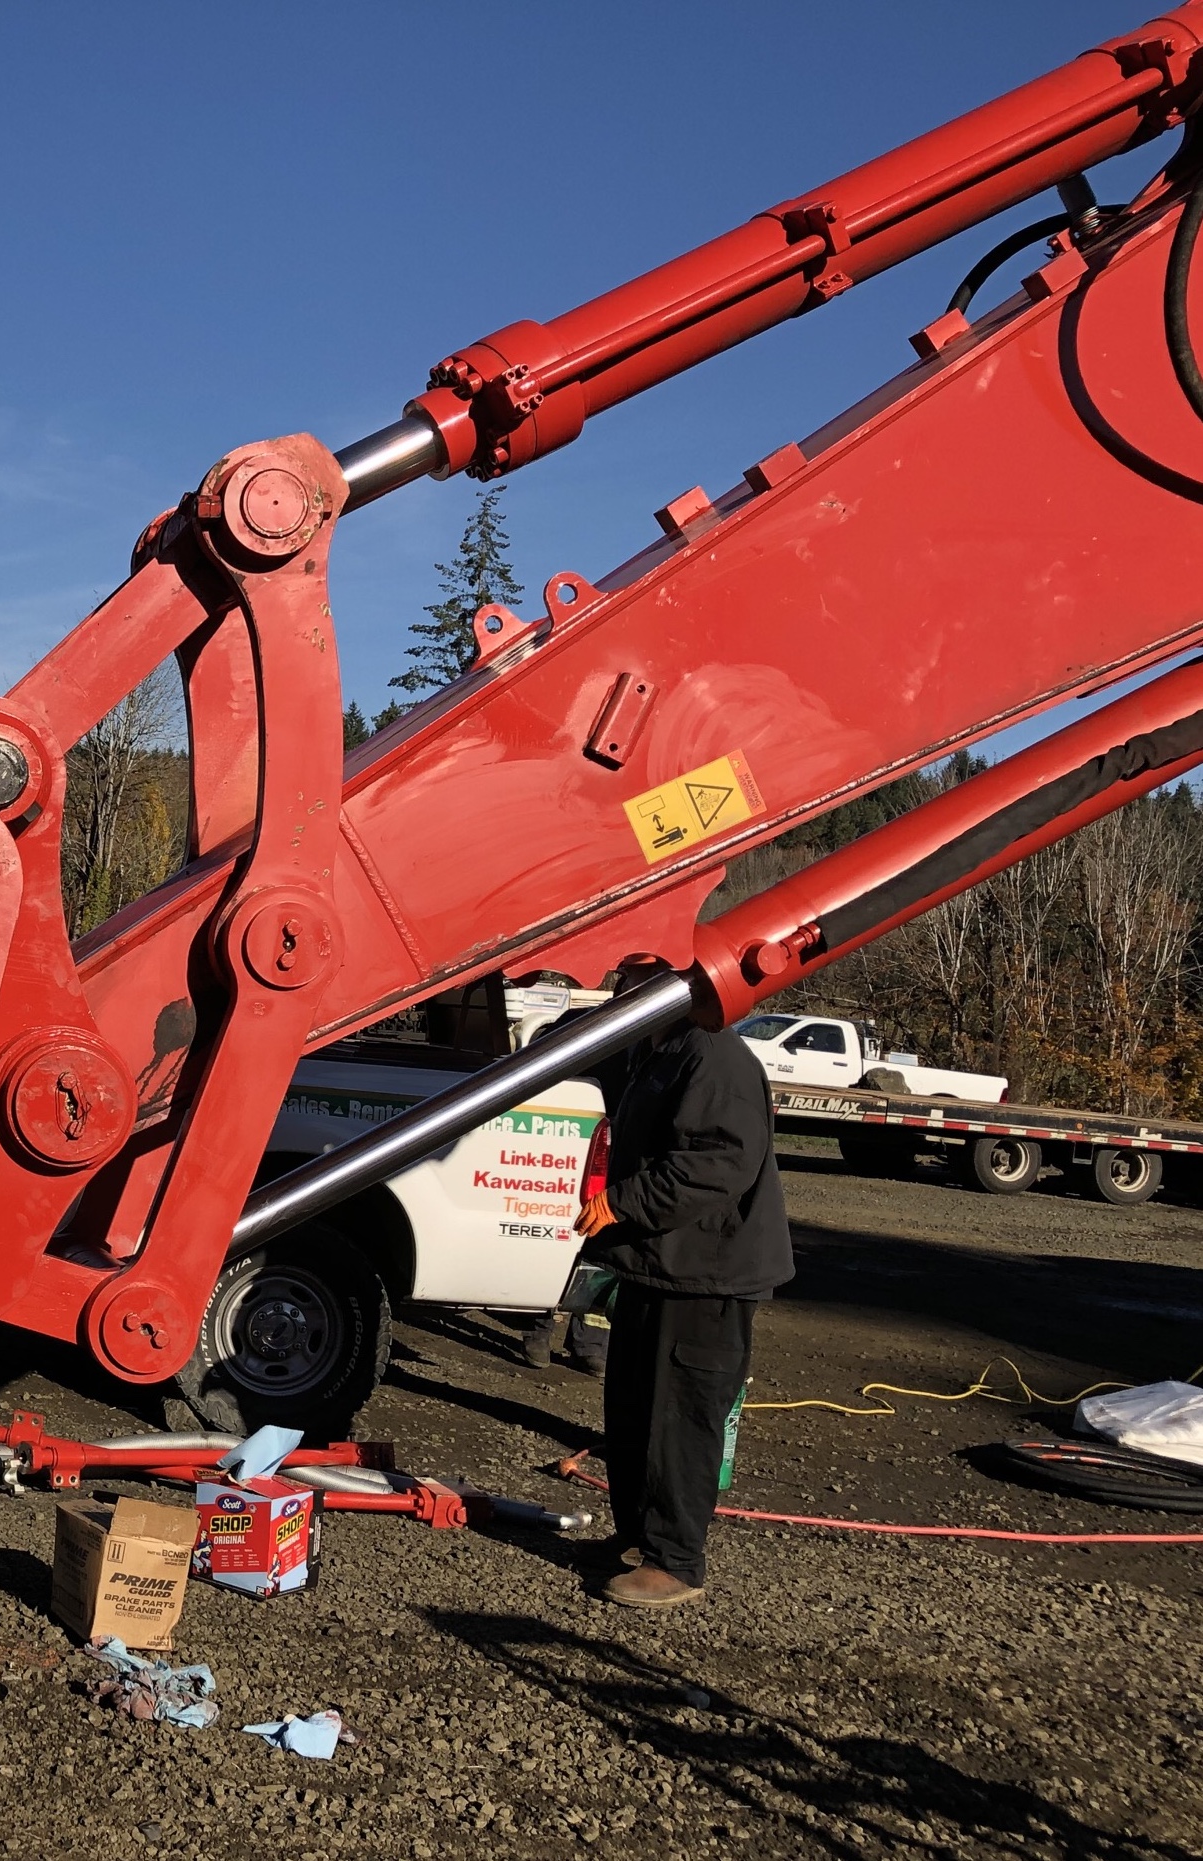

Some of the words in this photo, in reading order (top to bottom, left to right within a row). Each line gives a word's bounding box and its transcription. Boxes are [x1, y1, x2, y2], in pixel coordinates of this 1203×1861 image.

[531, 1115, 581, 1138] Parts
[499, 1150, 577, 1170] Link-Belt
[473, 1170, 576, 1195] Kawasaki
[503, 1196, 573, 1218] Tigercat
[499, 1223, 554, 1239] TEREX
[226, 1257, 252, 1277] T/A
[222, 1498, 242, 1510] Scott
[210, 1515, 252, 1533] SHOP
[276, 1511, 305, 1544] SHOP
[213, 1535, 246, 1545] ORIGINAL
[162, 1549, 188, 1559] BCN20
[104, 1593, 140, 1605] BRAKE
[142, 1598, 175, 1609] PARTS
[128, 1587, 172, 1598] GUARD
[115, 1603, 163, 1616] CLEANER
